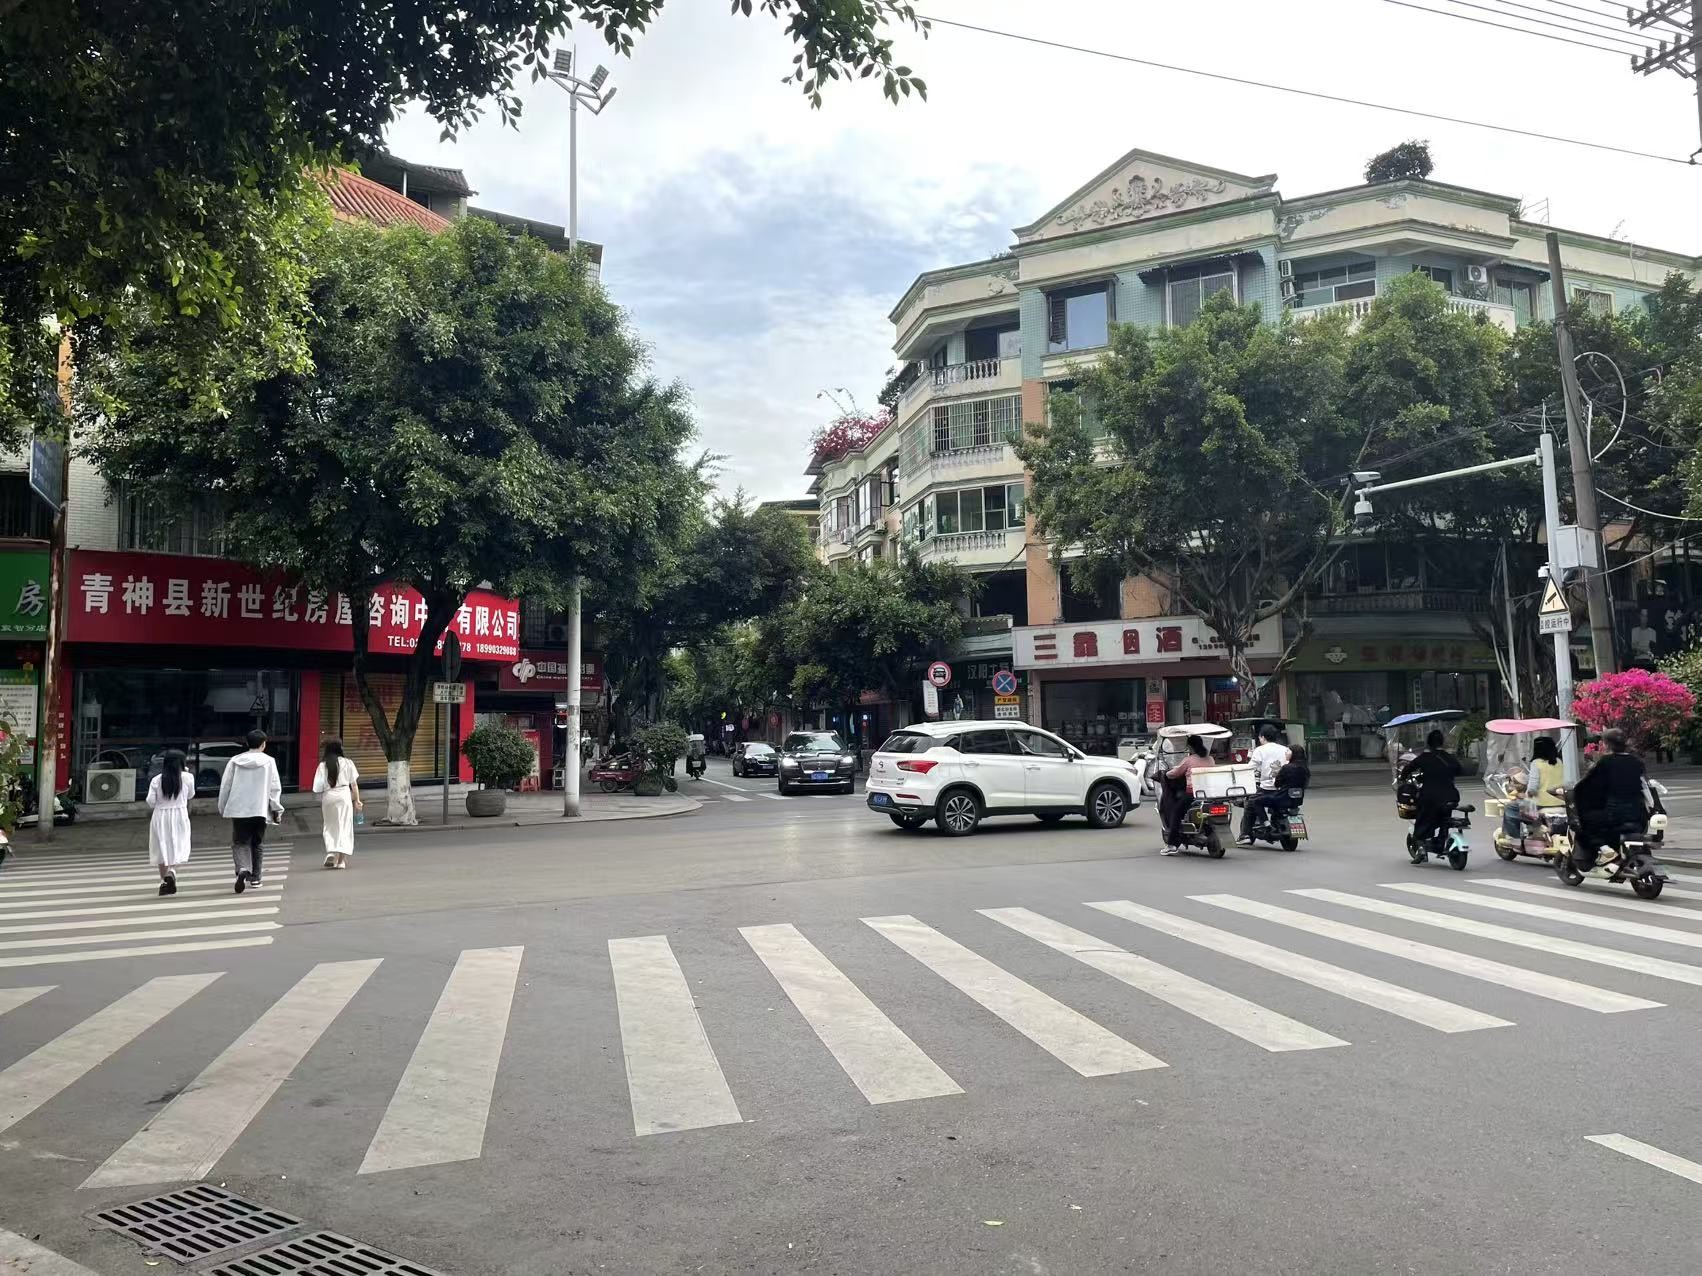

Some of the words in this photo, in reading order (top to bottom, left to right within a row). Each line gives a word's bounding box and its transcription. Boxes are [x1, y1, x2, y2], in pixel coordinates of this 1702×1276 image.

[80, 572, 518, 641] 青神县新世纪房屋咨询中有限公司
